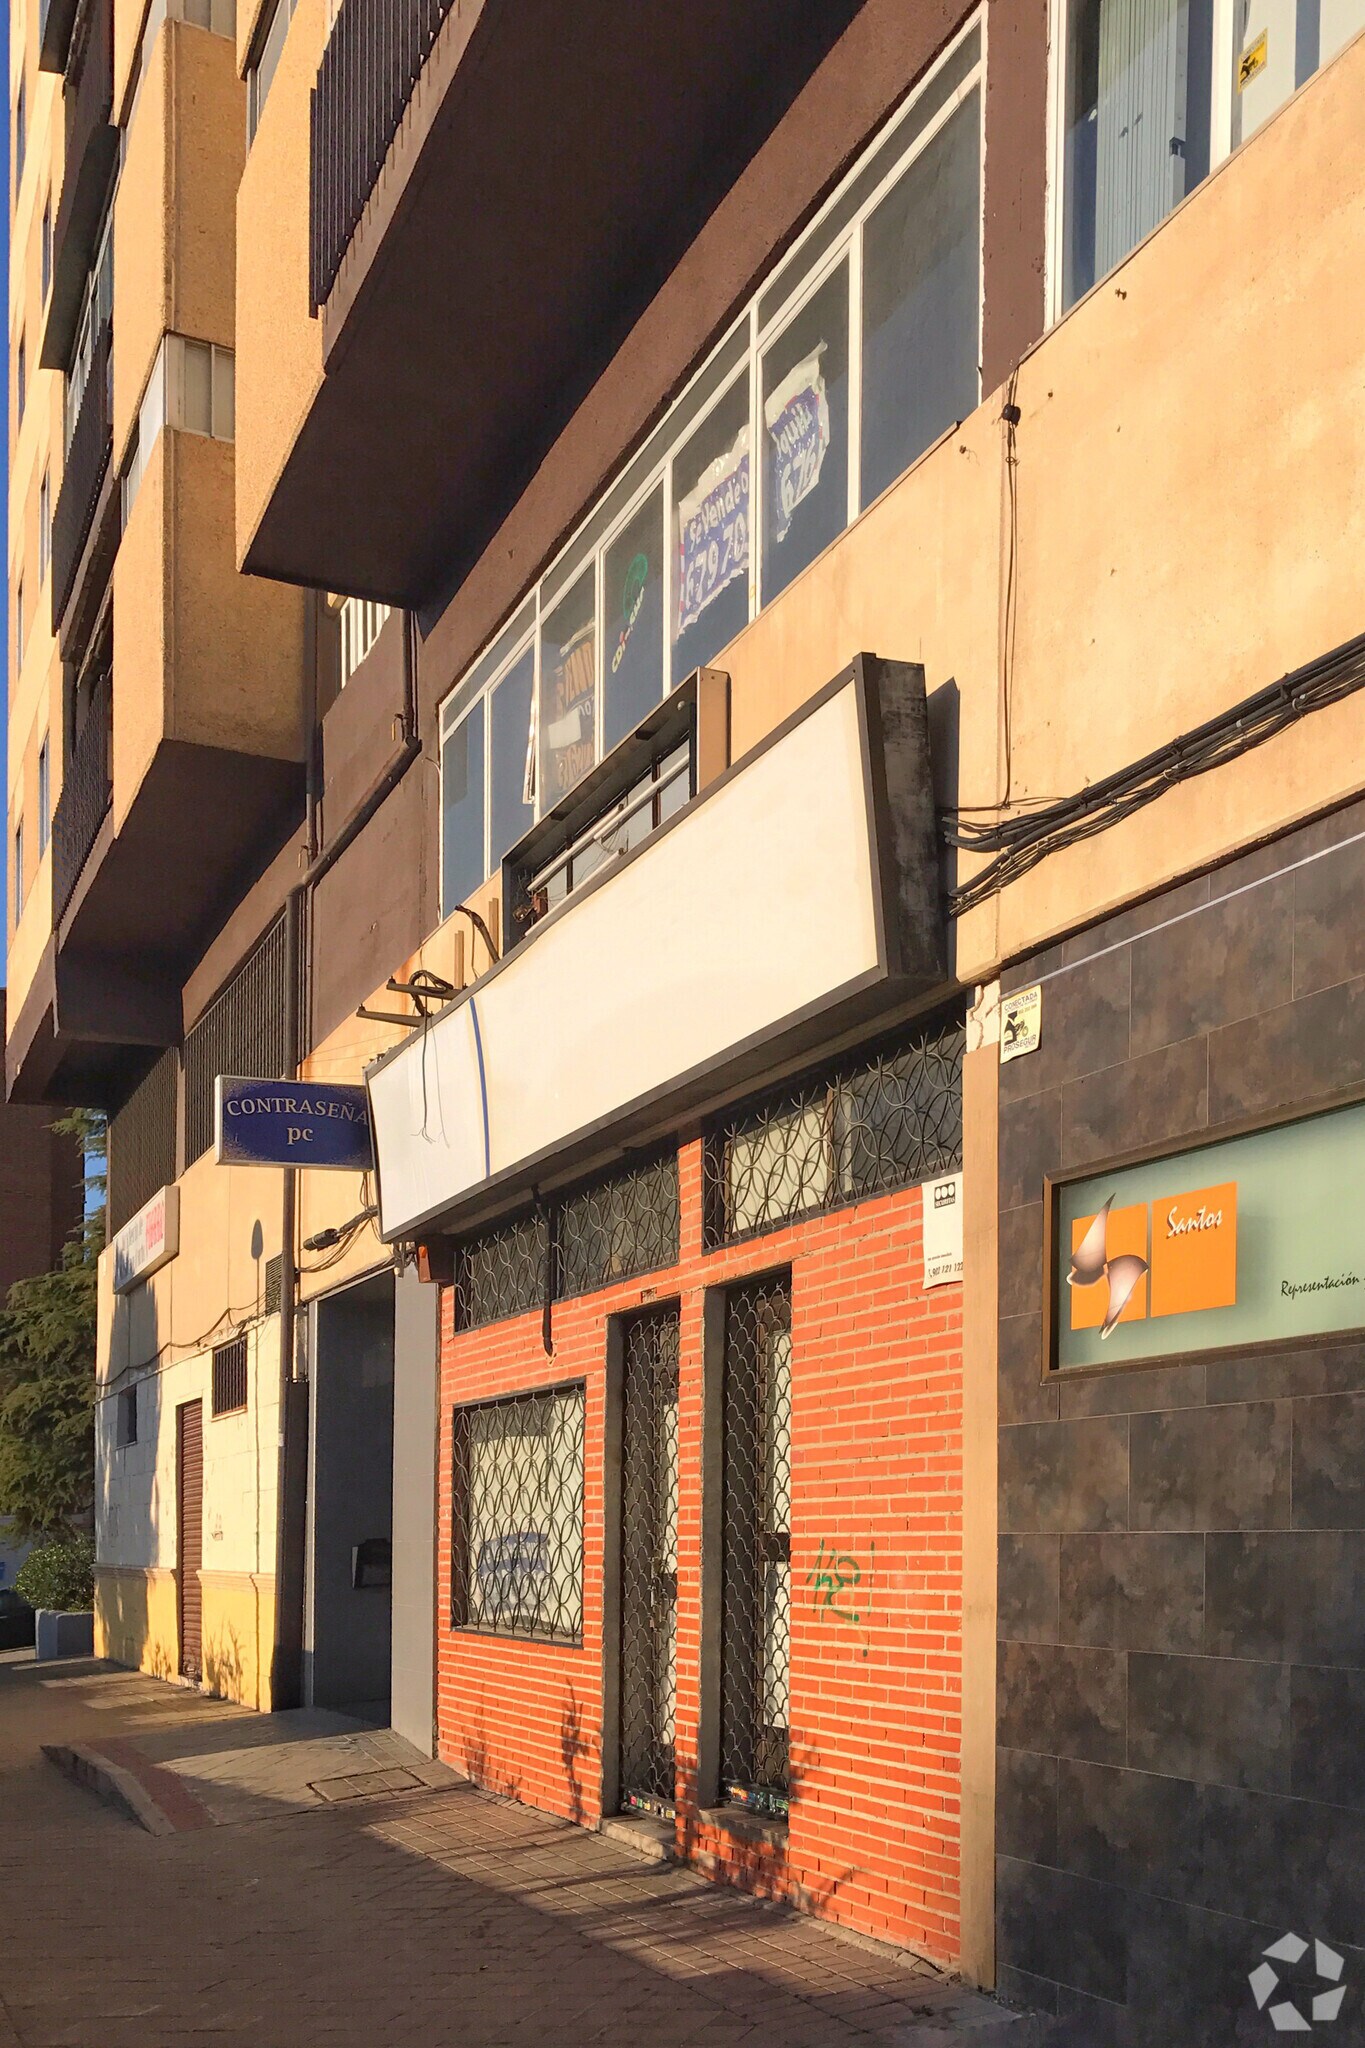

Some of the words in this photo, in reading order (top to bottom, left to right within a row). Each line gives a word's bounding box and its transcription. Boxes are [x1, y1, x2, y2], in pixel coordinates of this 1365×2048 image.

[226, 1097, 369, 1126] CONTRASEÑA
[287, 1126, 314, 1145] pc
[1166, 1205, 1223, 1238] Santos
[1281, 1271, 1360, 1301] Representación
